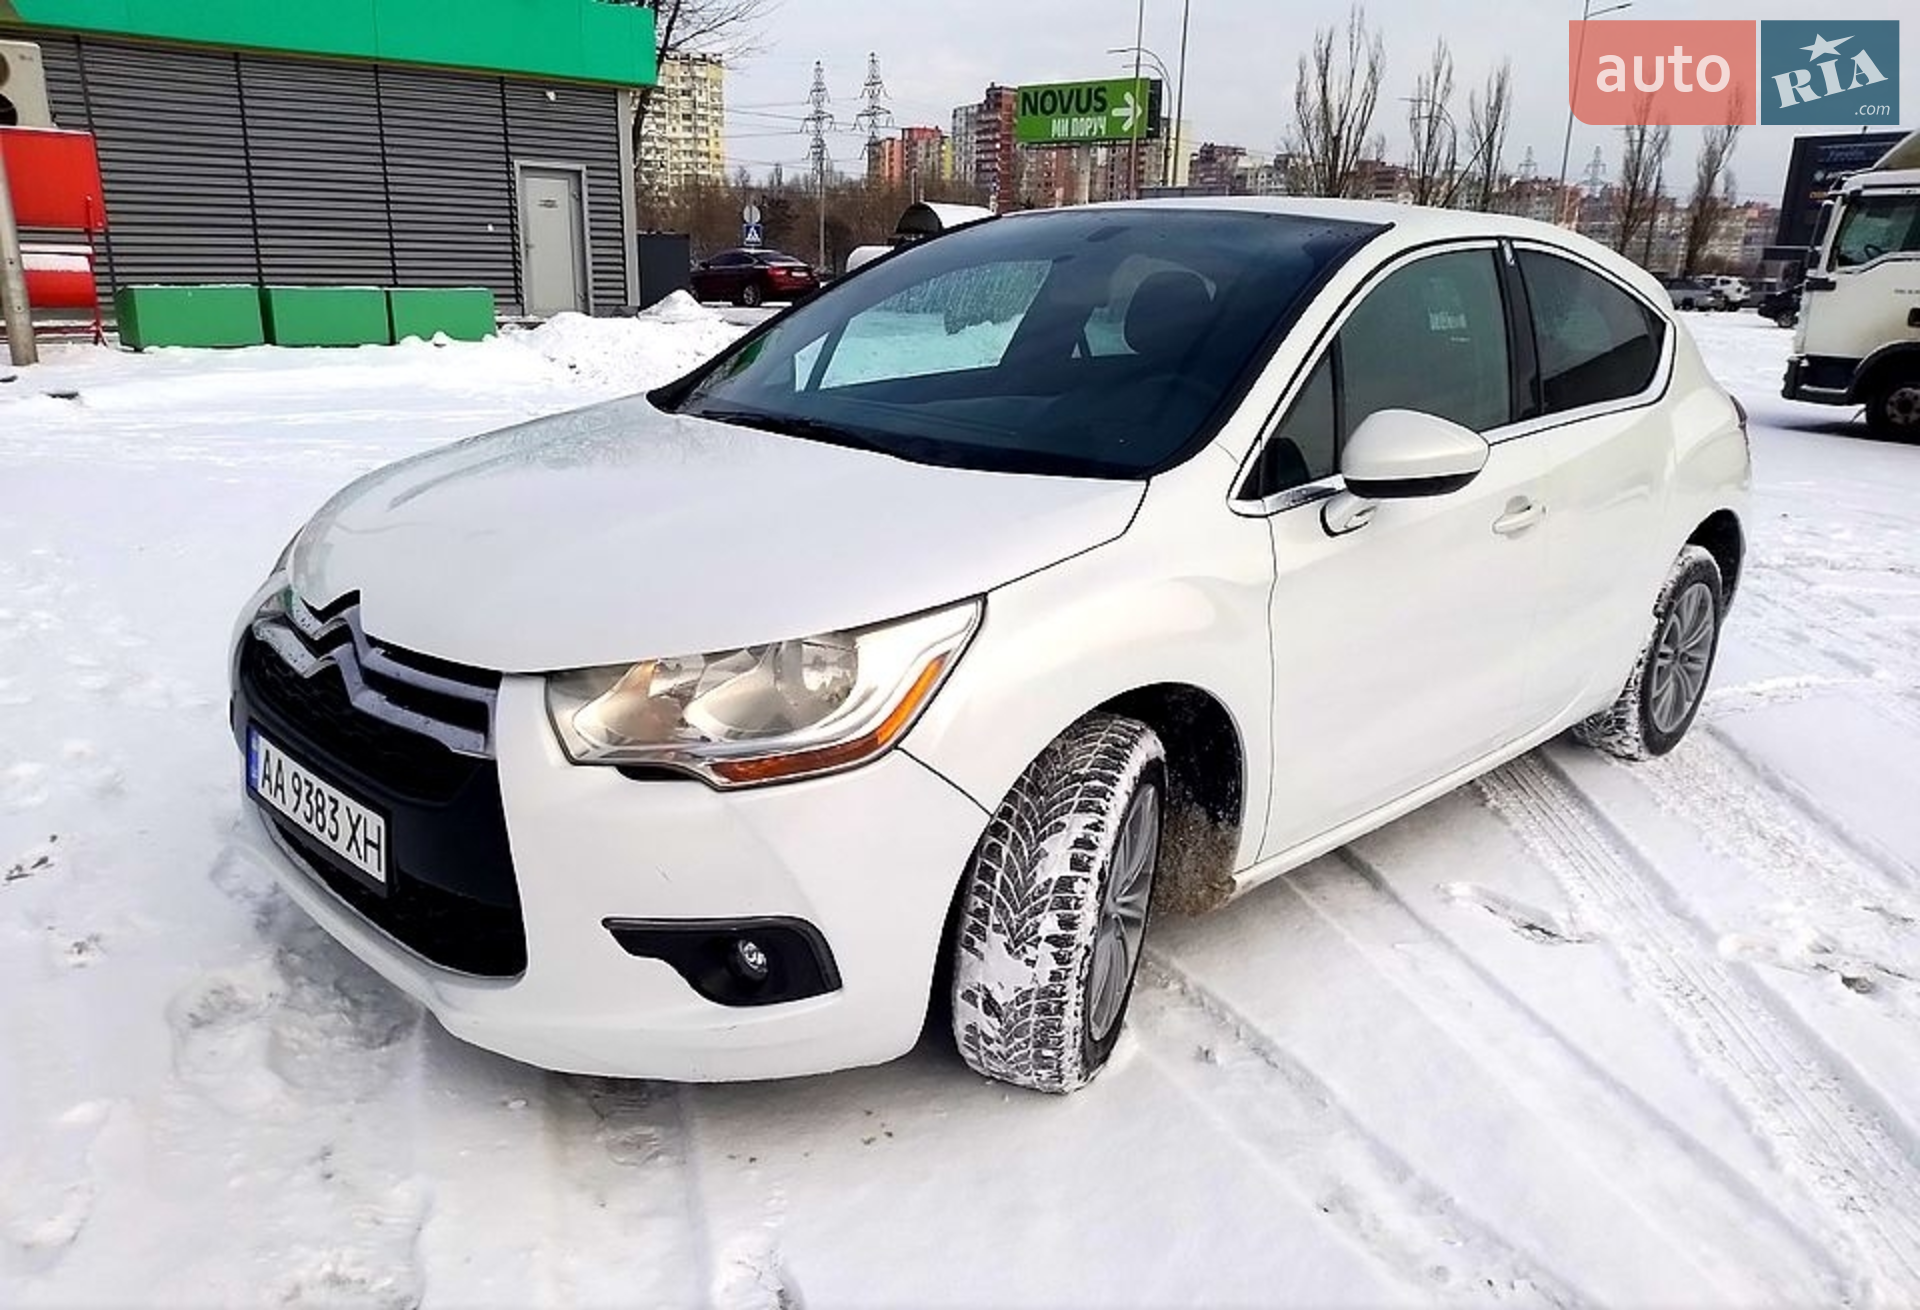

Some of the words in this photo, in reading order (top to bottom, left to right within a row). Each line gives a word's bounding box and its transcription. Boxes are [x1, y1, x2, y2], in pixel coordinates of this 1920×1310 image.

[1021, 87, 1108, 116] NOVUS
[1051, 118, 1069, 138] МИ
[1071, 116, 1107, 137] ПОРУЧ
[262, 749, 286, 805] AA
[292, 771, 339, 842] 9383
[346, 806, 381, 873] XH
